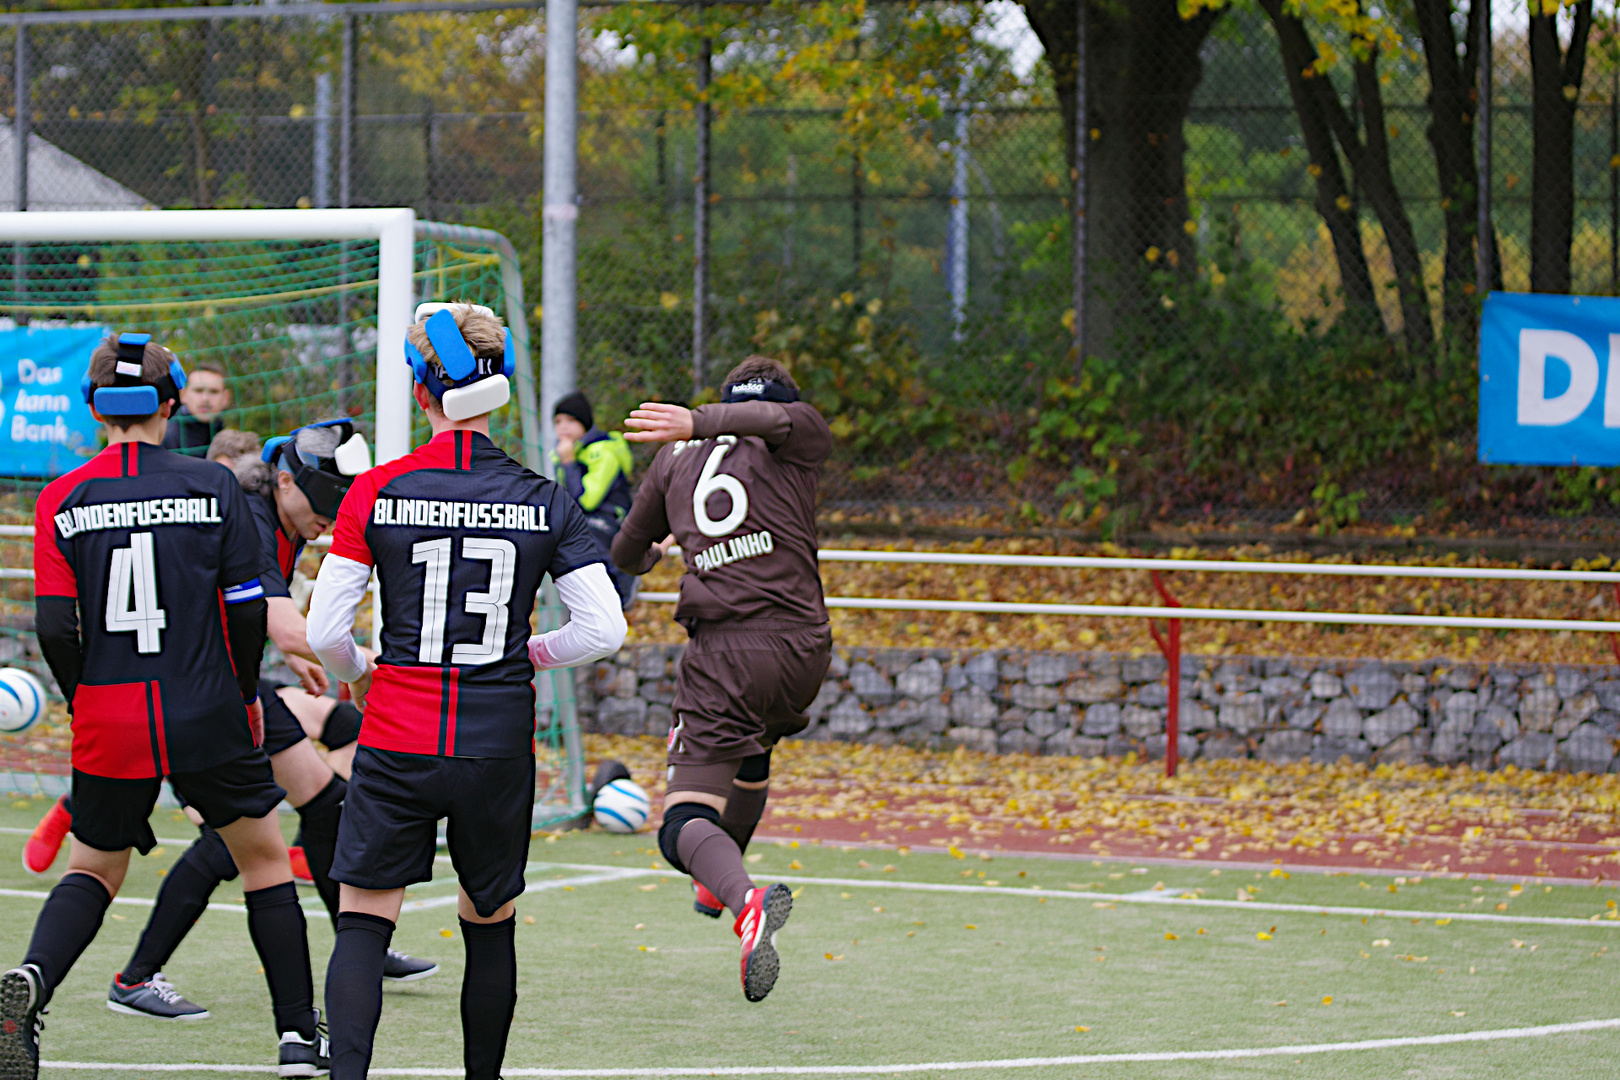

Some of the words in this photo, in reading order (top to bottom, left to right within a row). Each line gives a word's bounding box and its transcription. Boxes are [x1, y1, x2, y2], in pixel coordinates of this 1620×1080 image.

[18, 358, 62, 385] Das
[1518, 328, 1620, 428] D
[15, 390, 70, 412] kann
[12, 415, 67, 443] Bank
[694, 435, 747, 536] 6
[54, 498, 222, 538] BLINDENFUSSBALL
[374, 498, 550, 532] BLINDENFUSSBALL
[695, 531, 773, 571] PAULINHO
[106, 532, 166, 653] 4
[412, 537, 516, 665] 13
